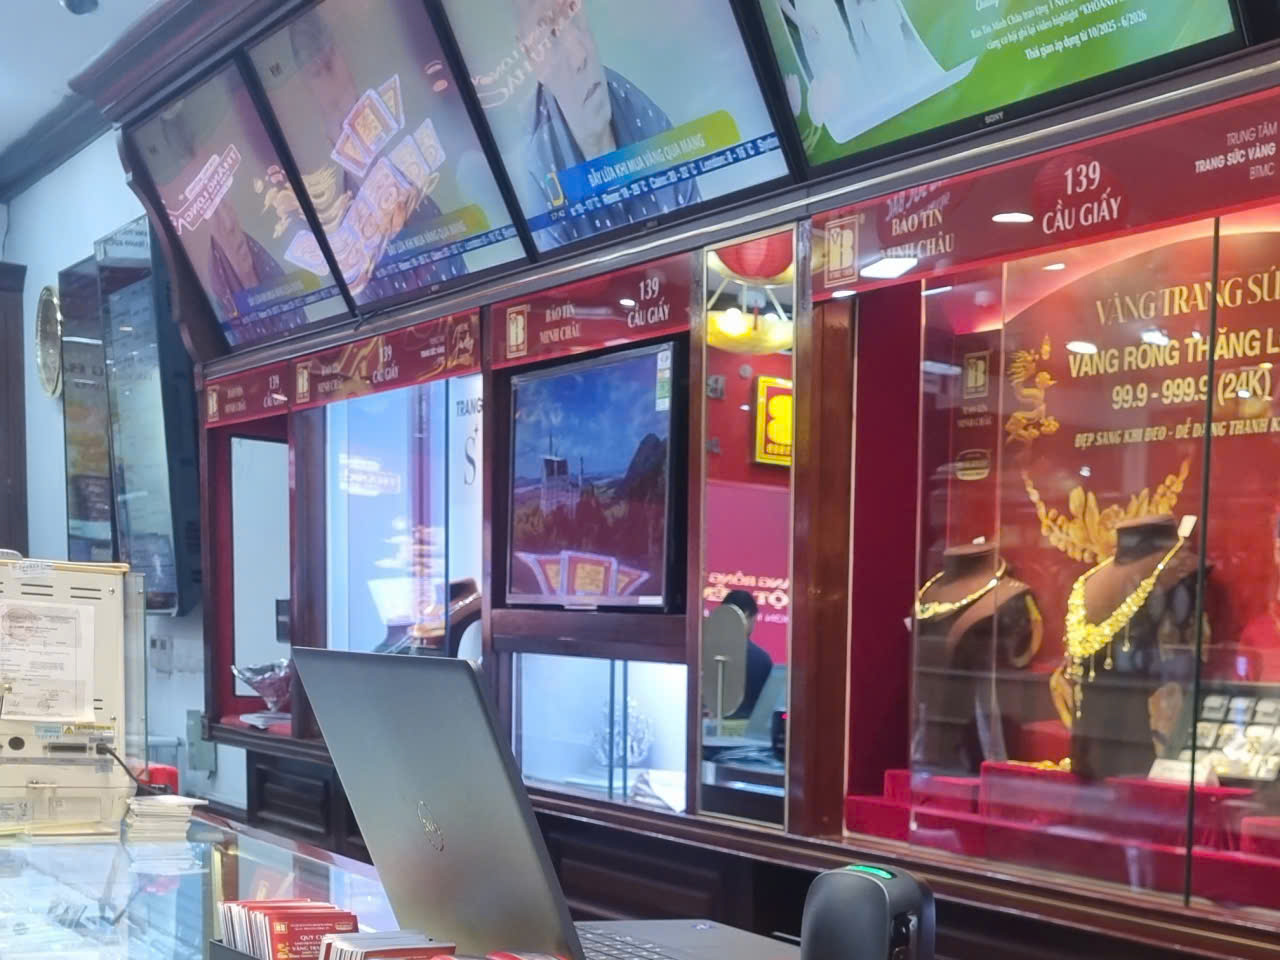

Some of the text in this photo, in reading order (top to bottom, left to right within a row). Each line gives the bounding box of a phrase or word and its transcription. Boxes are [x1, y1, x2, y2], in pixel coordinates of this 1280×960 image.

[1226, 120, 1279, 147] TRUNG TÂM
[1194, 141, 1277, 175] TRANG SỨC VÀNG
[1249, 161, 1276, 180] BTMC
[1063, 160, 1102, 195] 139
[1041, 186, 1123, 236] CẦU GIẤY
[917, 231, 955, 259] CHÂU
[638, 276, 659, 301] 139
[1095, 289, 1158, 328] VÀNG
[1159, 276, 1243, 319] TRANG
[627, 297, 670, 328] CẦU GIẤY
[1183, 325, 1262, 364] THĂNG
[1111, 382, 1149, 411] 99.9
[1161, 376, 1210, 406] 999.9
[1216, 367, 1273, 407] (24K)
[1094, 428, 1123, 447] SANG
[1122, 427, 1144, 444] KHI
[1228, 413, 1269, 434] THANH
